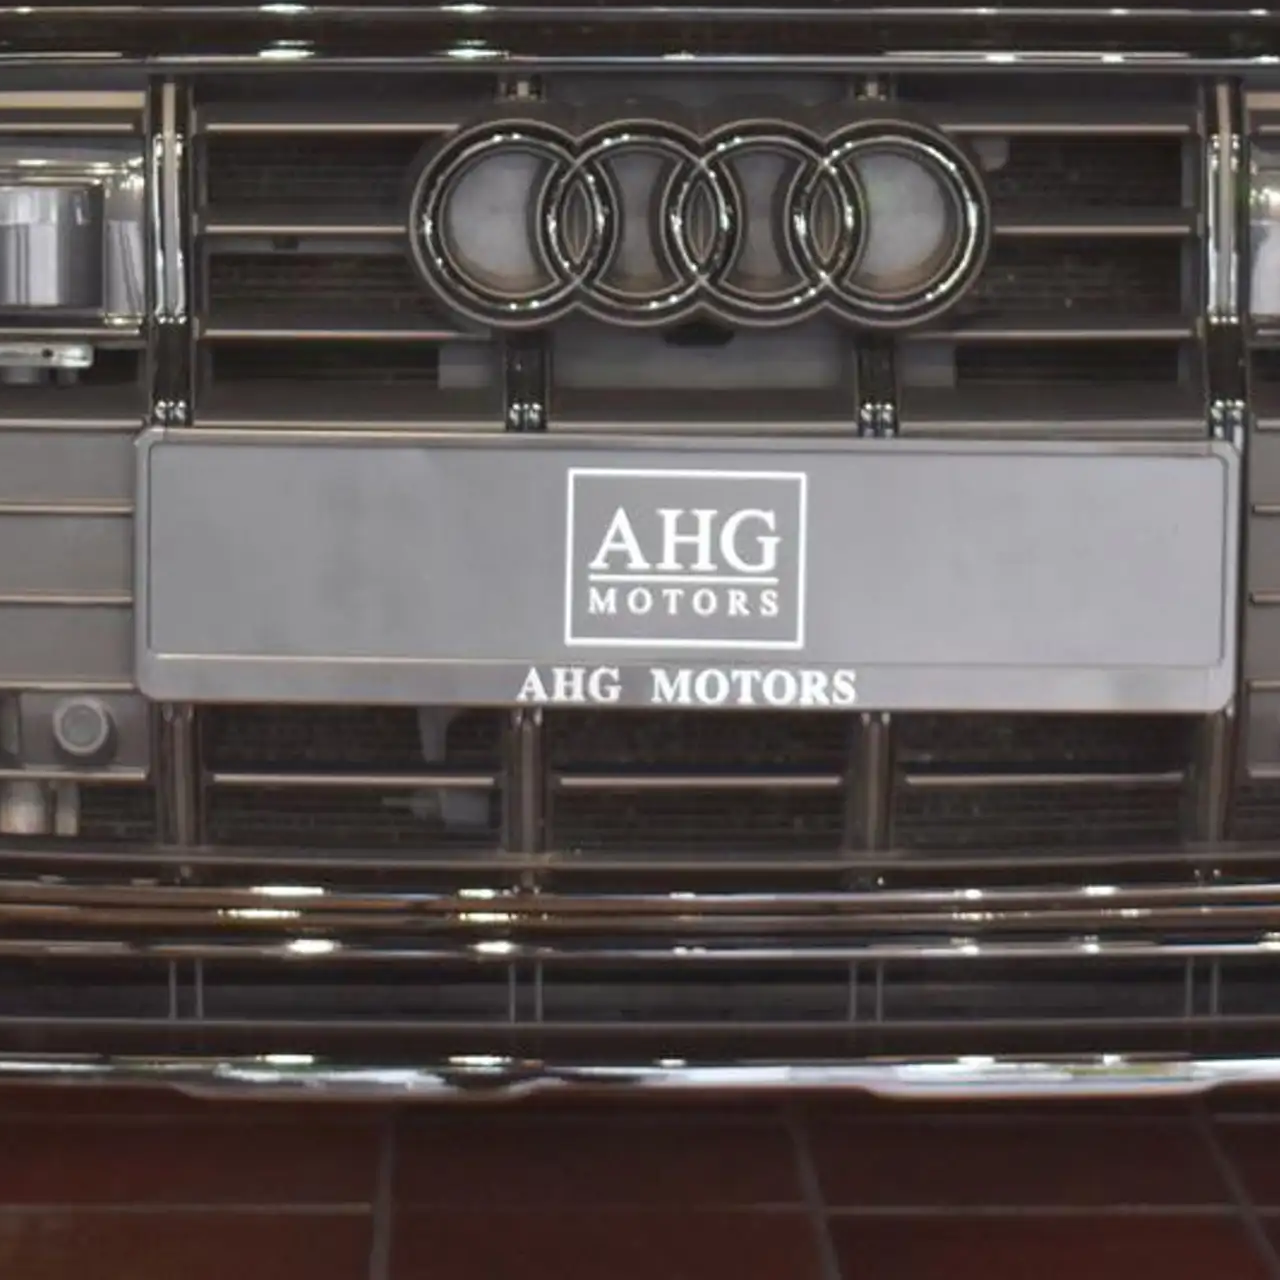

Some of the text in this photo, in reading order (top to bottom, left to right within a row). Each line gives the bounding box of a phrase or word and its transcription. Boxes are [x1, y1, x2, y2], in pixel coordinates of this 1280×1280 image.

[588, 506, 781, 573] AHG
[588, 587, 780, 616] MOTORS
[517, 667, 857, 705] AHG MOTORS
